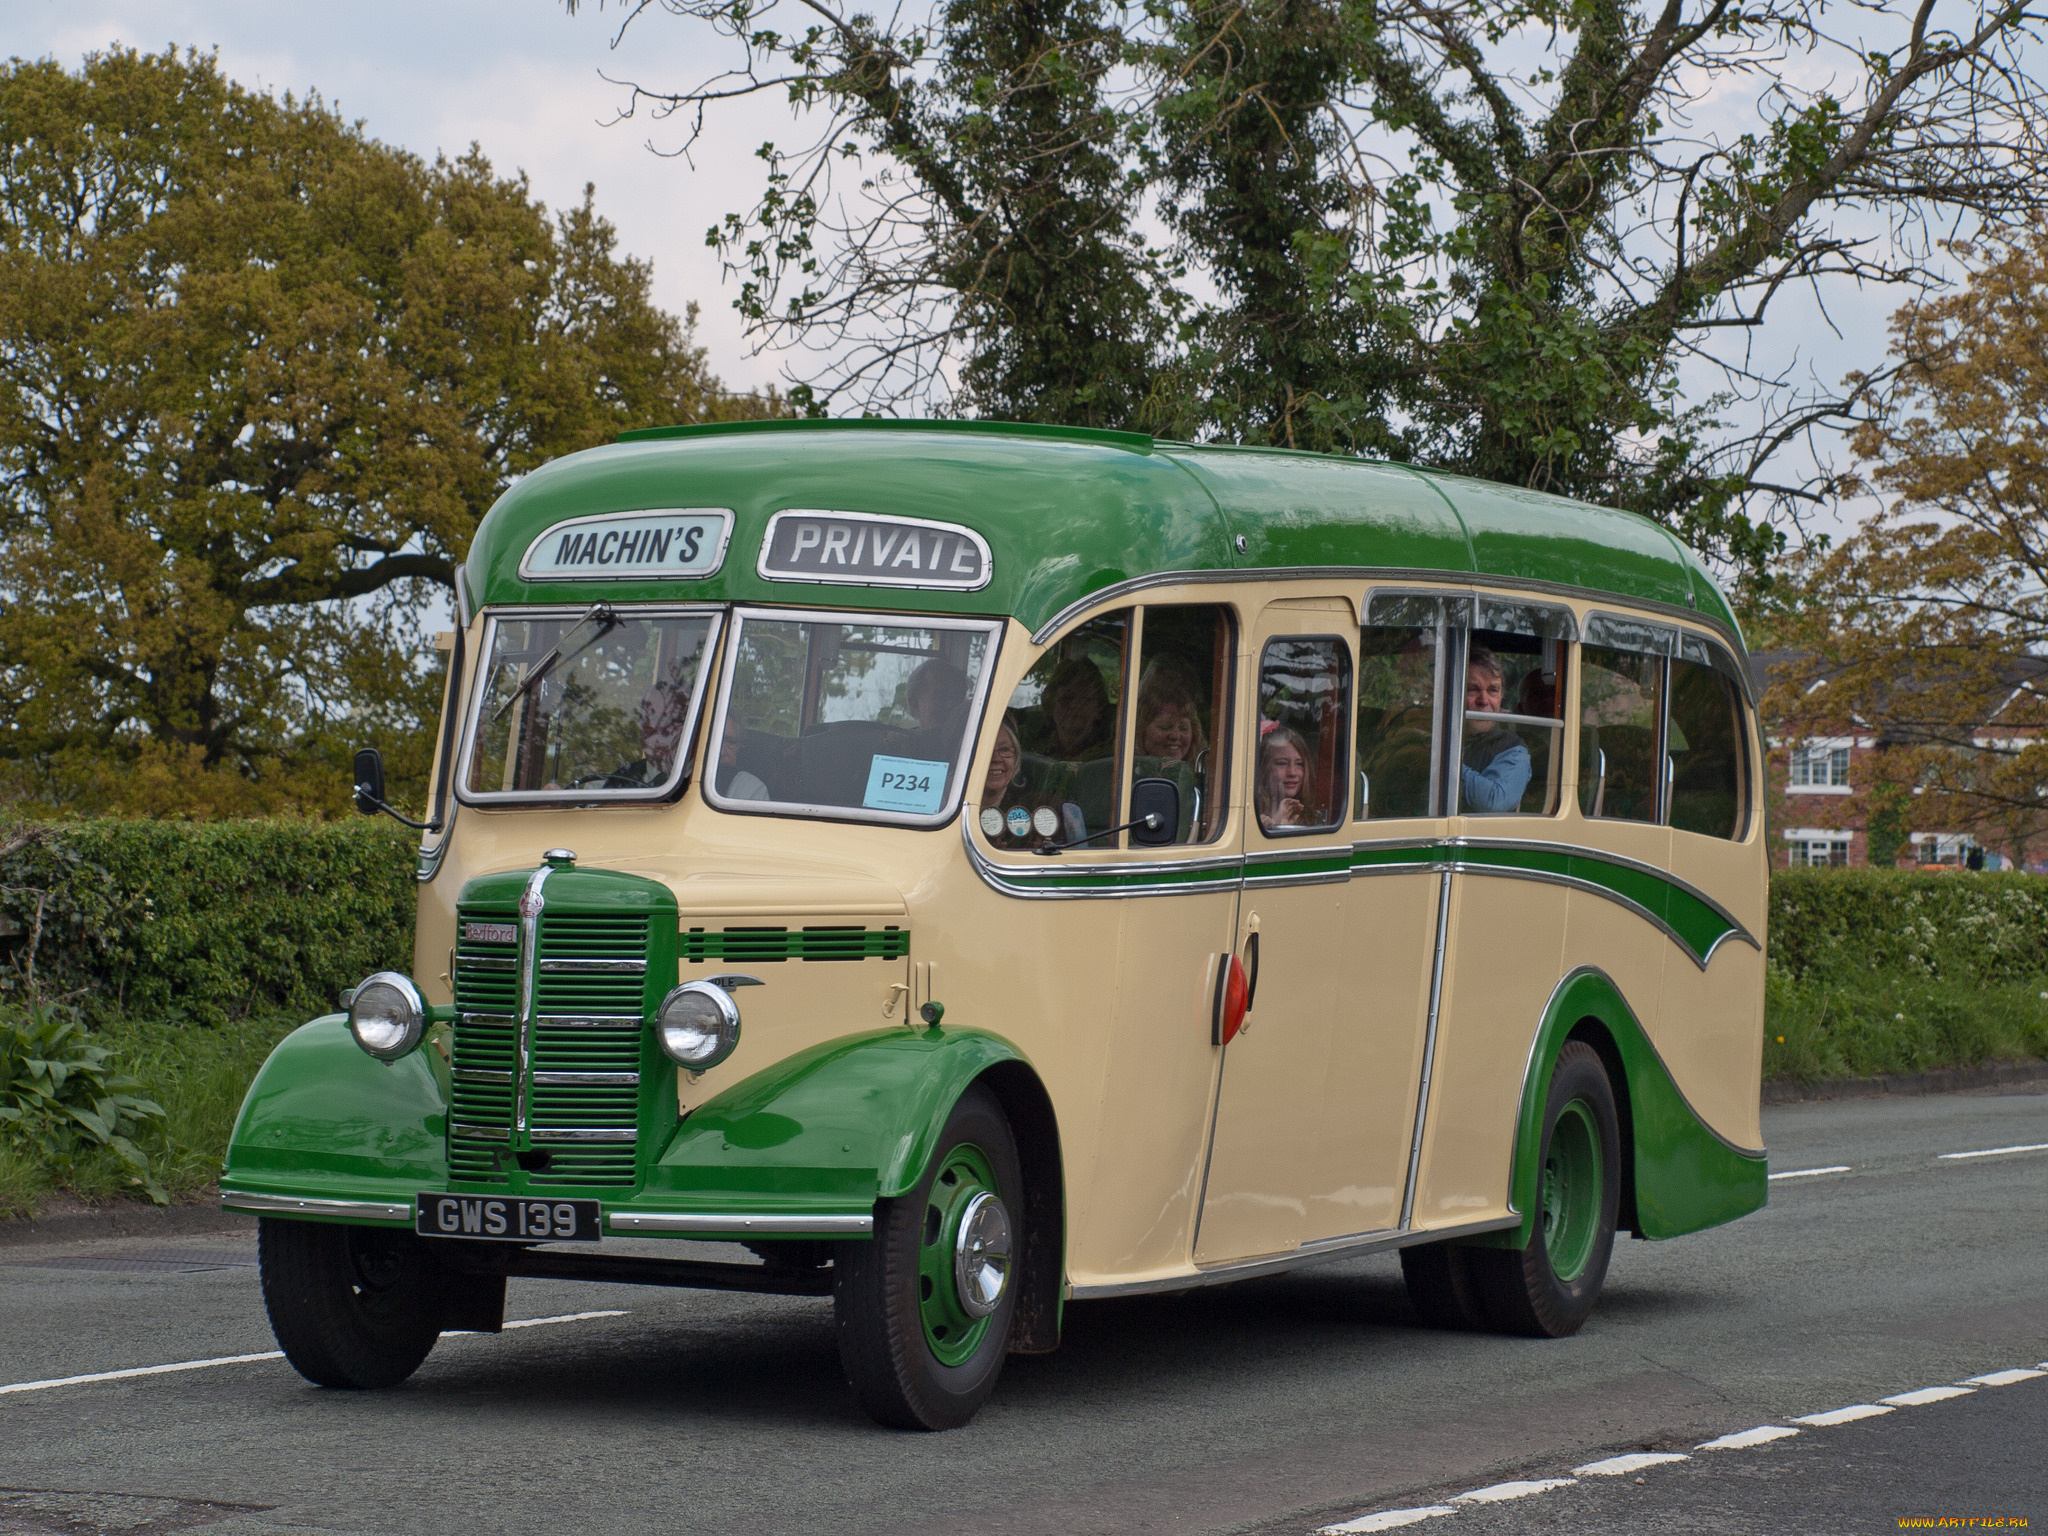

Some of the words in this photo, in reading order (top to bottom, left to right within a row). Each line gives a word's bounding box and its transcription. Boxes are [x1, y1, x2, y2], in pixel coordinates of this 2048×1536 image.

[554, 526, 704, 565] MACHIN'S
[790, 523, 977, 574] PRIVATE
[881, 772, 930, 792] P234
[466, 924, 515, 941] Bedford
[437, 1199, 507, 1234] GWS
[519, 1202, 577, 1237] 139
